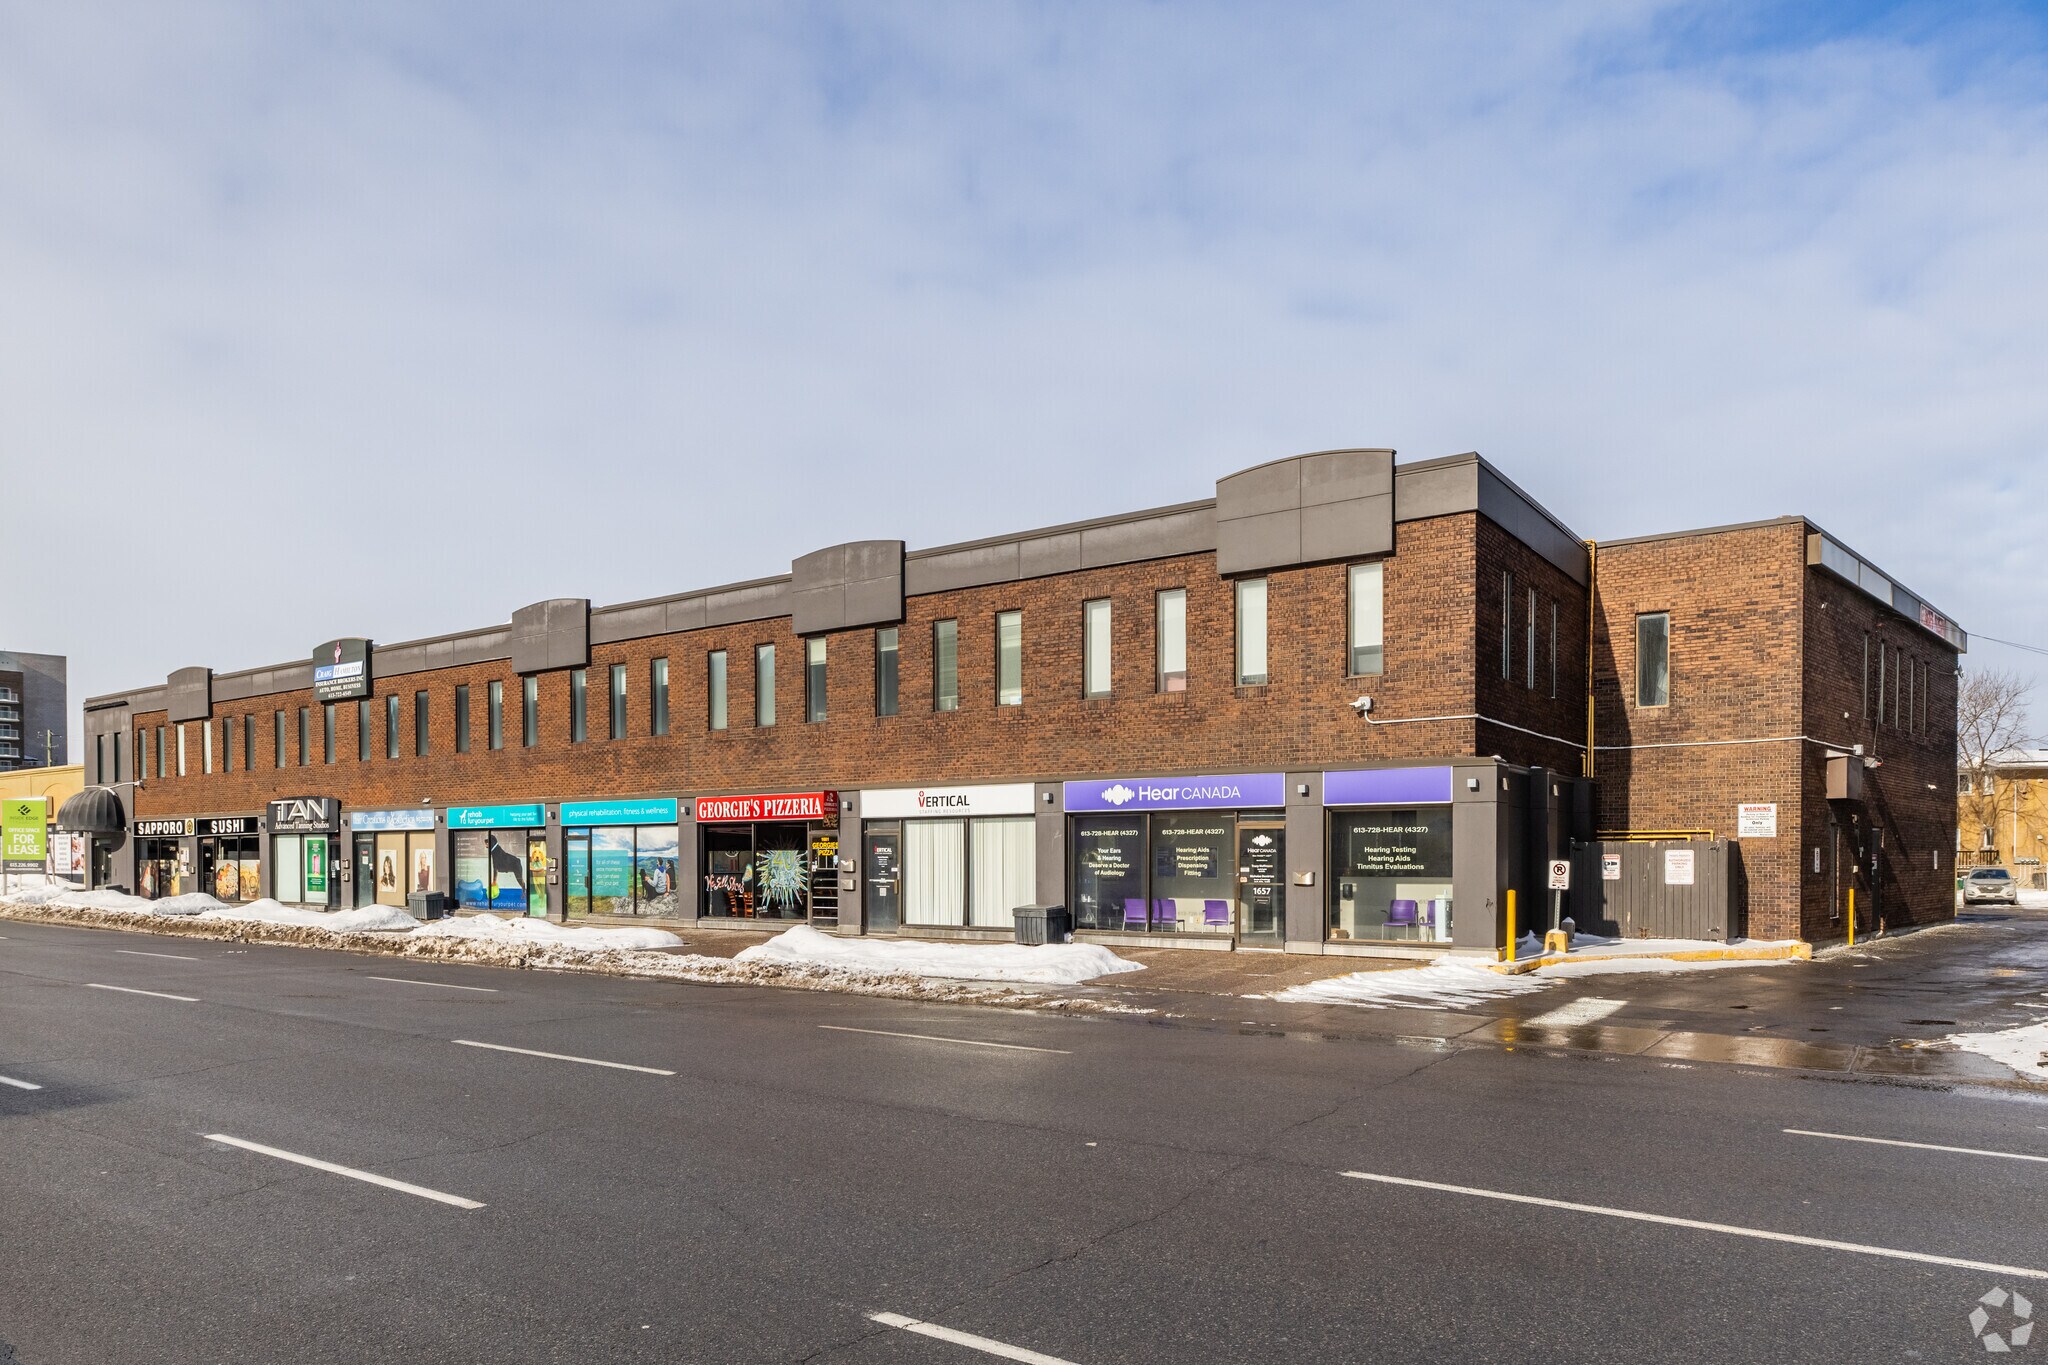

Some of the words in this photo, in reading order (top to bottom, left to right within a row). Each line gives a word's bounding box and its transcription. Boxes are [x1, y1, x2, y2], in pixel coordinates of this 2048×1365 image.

[918, 793, 970, 807] VERTICAL
[1139, 786, 1179, 800] Hear
[1182, 786, 1240, 800] CANADA
[568, 810, 588, 818] physical
[700, 799, 760, 818] GEORGIE'S
[764, 798, 822, 816] PIZZERIA
[138, 821, 182, 835] SAPPORO
[211, 819, 244, 833] SUSHI
[275, 822, 295, 830] Advanced
[295, 821, 313, 832] Tanning
[313, 820, 330, 829] Studios
[14, 834, 34, 844] FOR
[8, 845, 40, 855] LEASE
